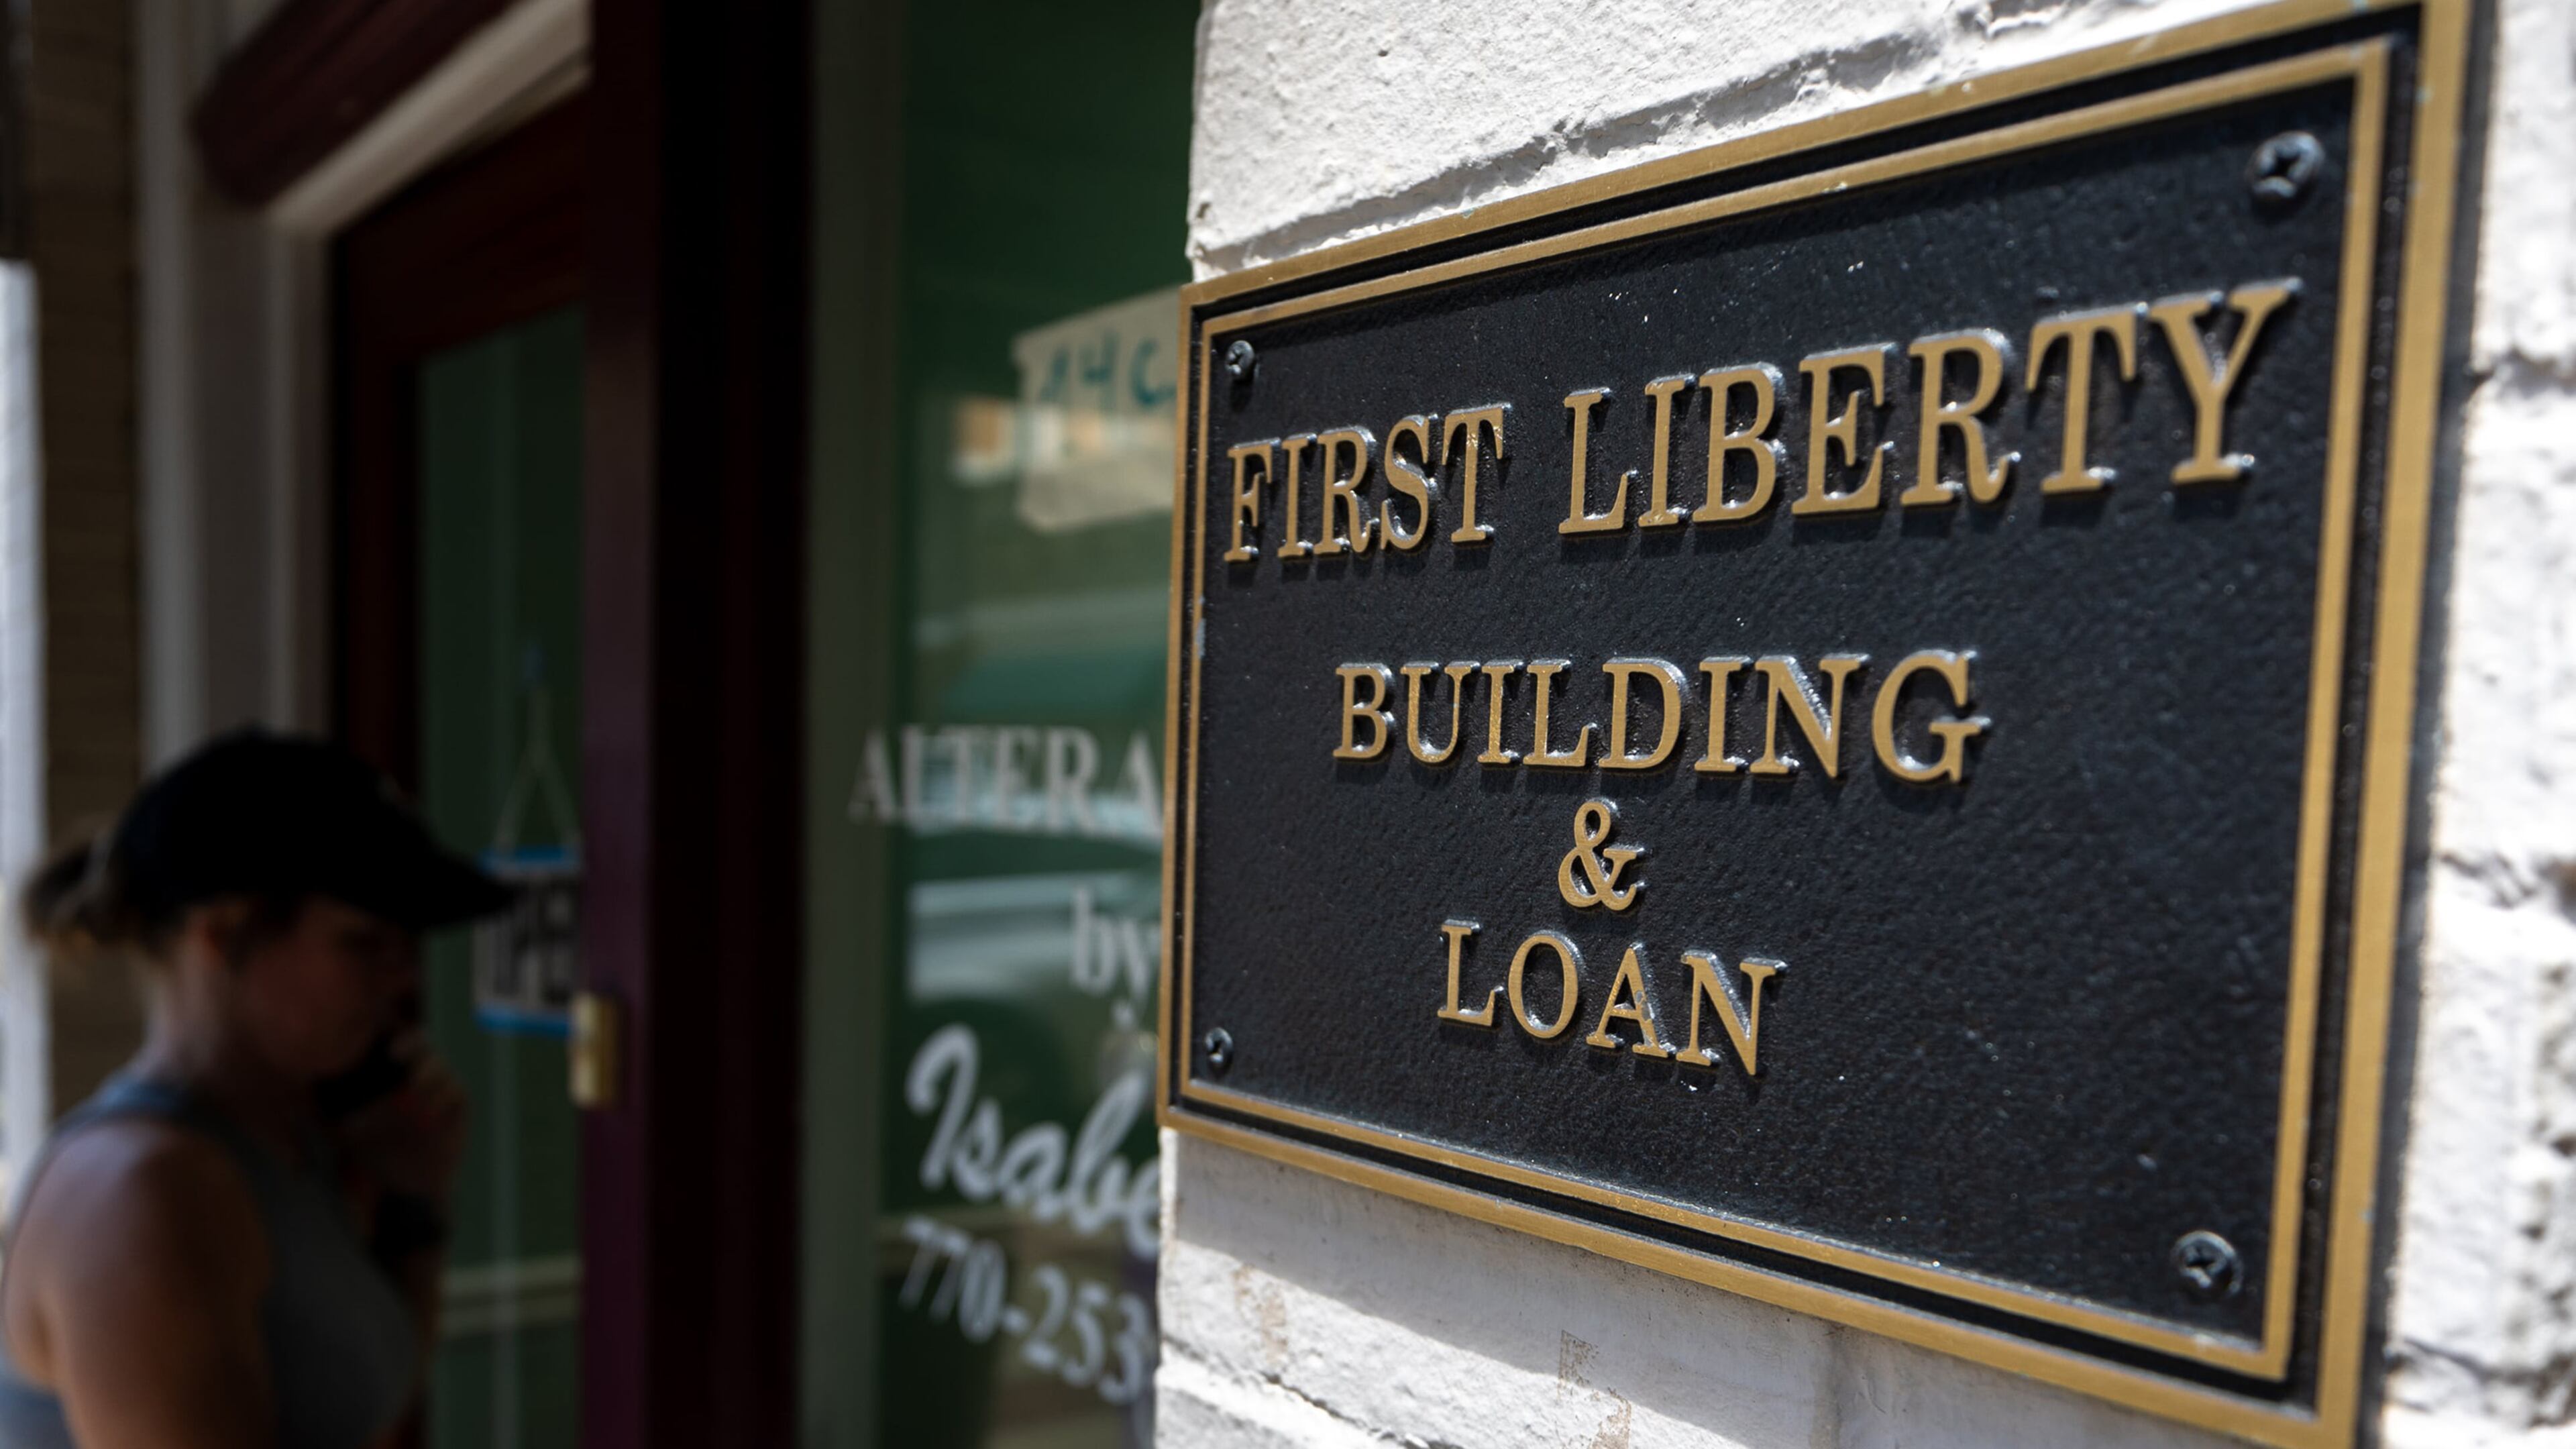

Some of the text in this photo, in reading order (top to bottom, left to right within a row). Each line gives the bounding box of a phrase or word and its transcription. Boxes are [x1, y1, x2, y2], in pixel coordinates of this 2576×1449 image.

[1224, 278, 2302, 564] FIRST LIBERTY
[1332, 649, 1990, 783] BUILDING
[1558, 798, 1646, 912] &
[1071, 883, 1162, 1028] by
[1437, 919, 1788, 1077] LOAN
